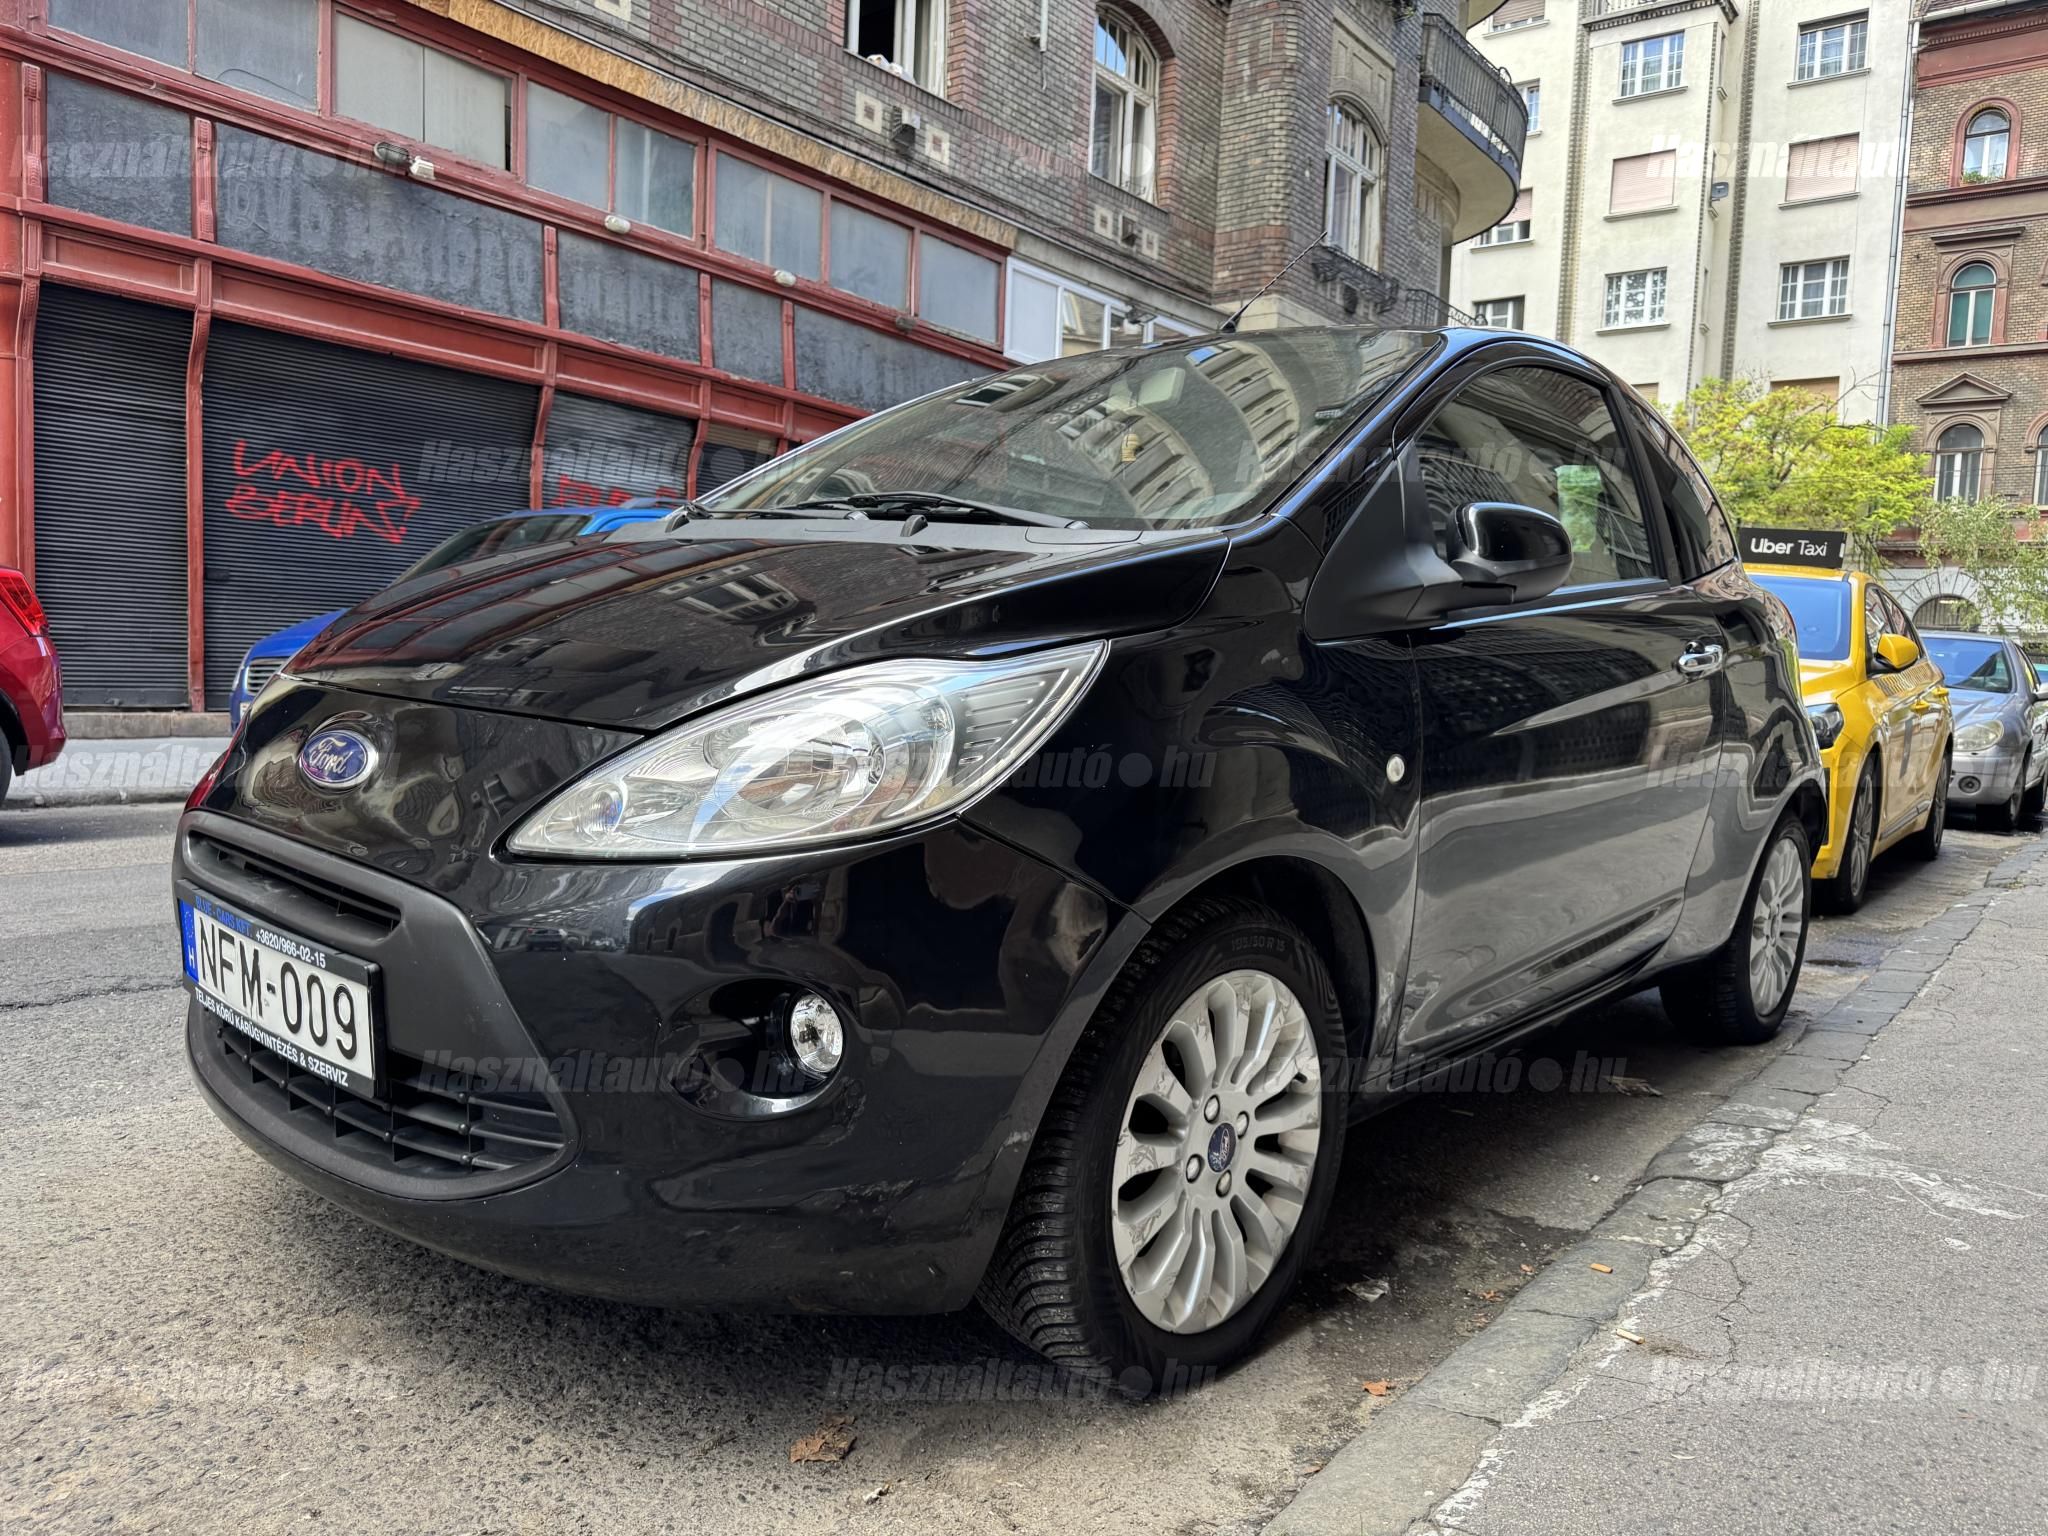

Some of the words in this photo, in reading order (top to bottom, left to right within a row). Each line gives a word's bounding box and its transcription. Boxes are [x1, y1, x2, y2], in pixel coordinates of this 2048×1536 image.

[232, 440, 406, 498] UNION
[225, 484, 421, 544] BERLIN
[1750, 537, 1795, 555] Uber
[1798, 540, 1828, 557] Taxi
[309, 737, 354, 774] Ford
[255, 929, 326, 968] +3620/966-02-15
[200, 916, 358, 1060] NFM-009
[195, 987, 215, 1013] TELJES
[299, 1051, 307, 1068] &
[308, 1056, 349, 1088] SZERVIZ
